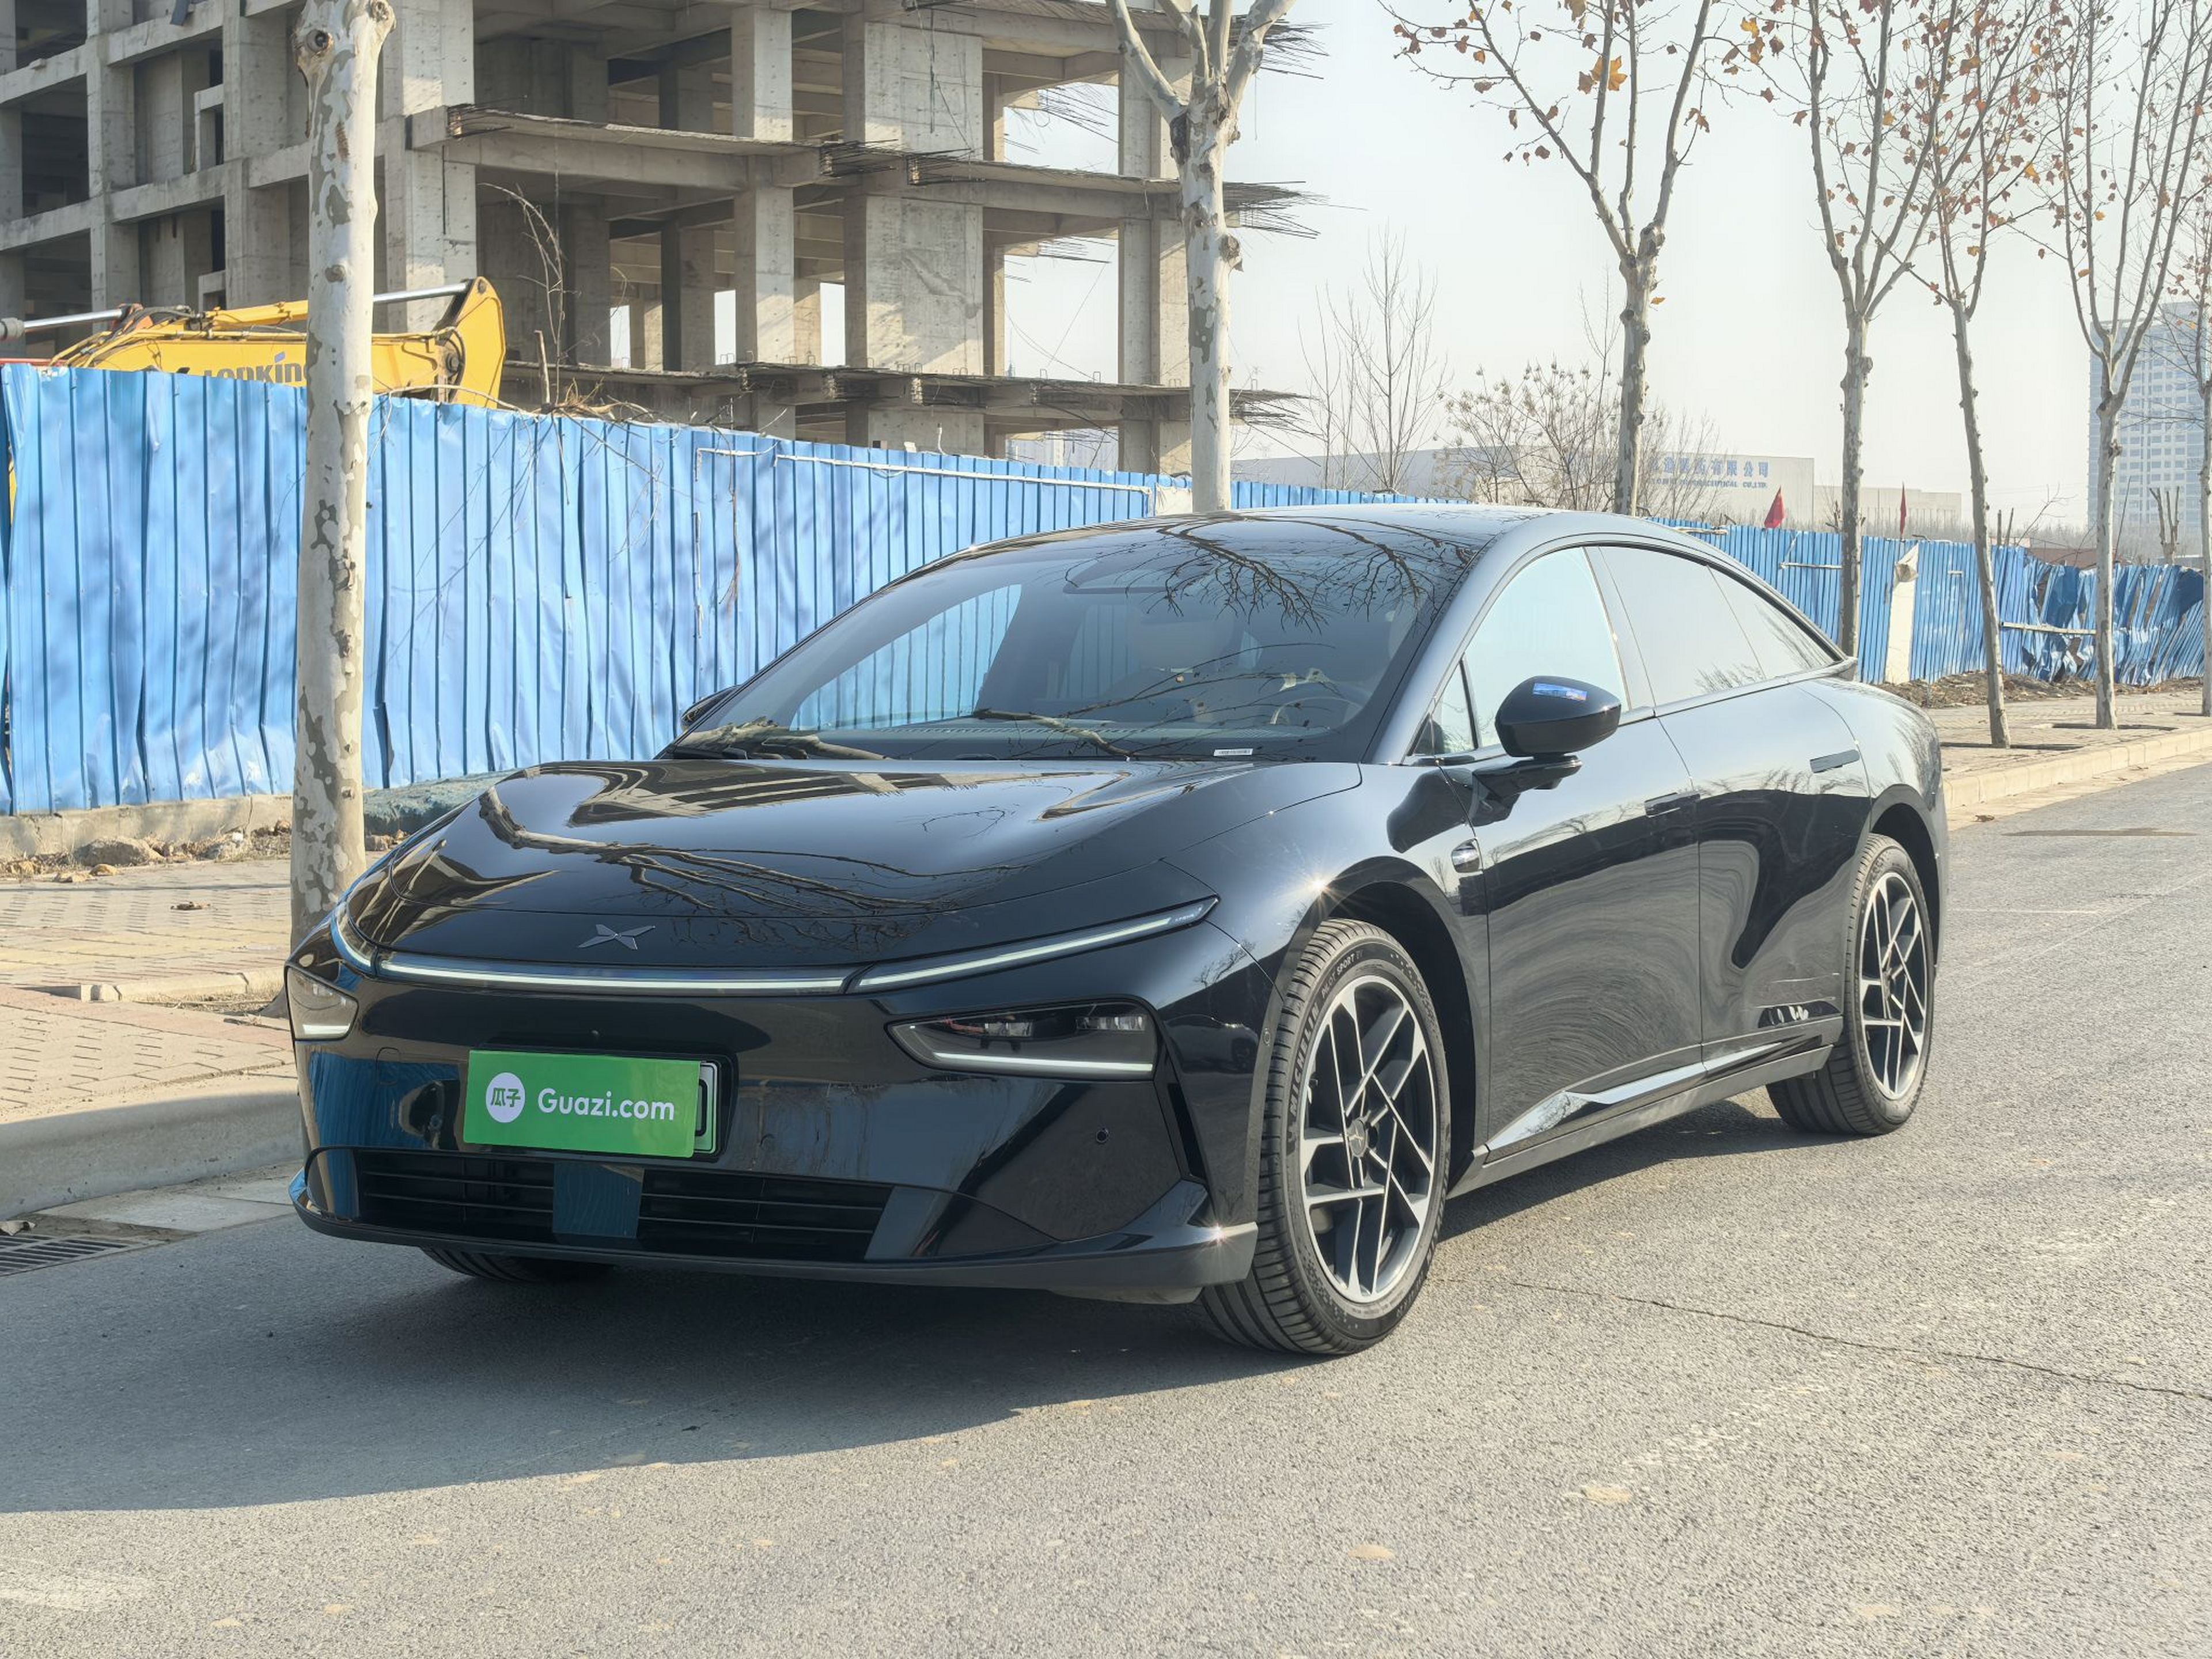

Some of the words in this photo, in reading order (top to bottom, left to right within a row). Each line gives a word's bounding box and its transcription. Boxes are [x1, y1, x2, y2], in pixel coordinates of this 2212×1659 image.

[1336, 953, 1355, 975] SPORT
[1289, 1001, 1320, 1117] MICHELIN
[490, 1087, 521, 1108] 瓜子
[537, 1087, 675, 1121] Guazi.com
